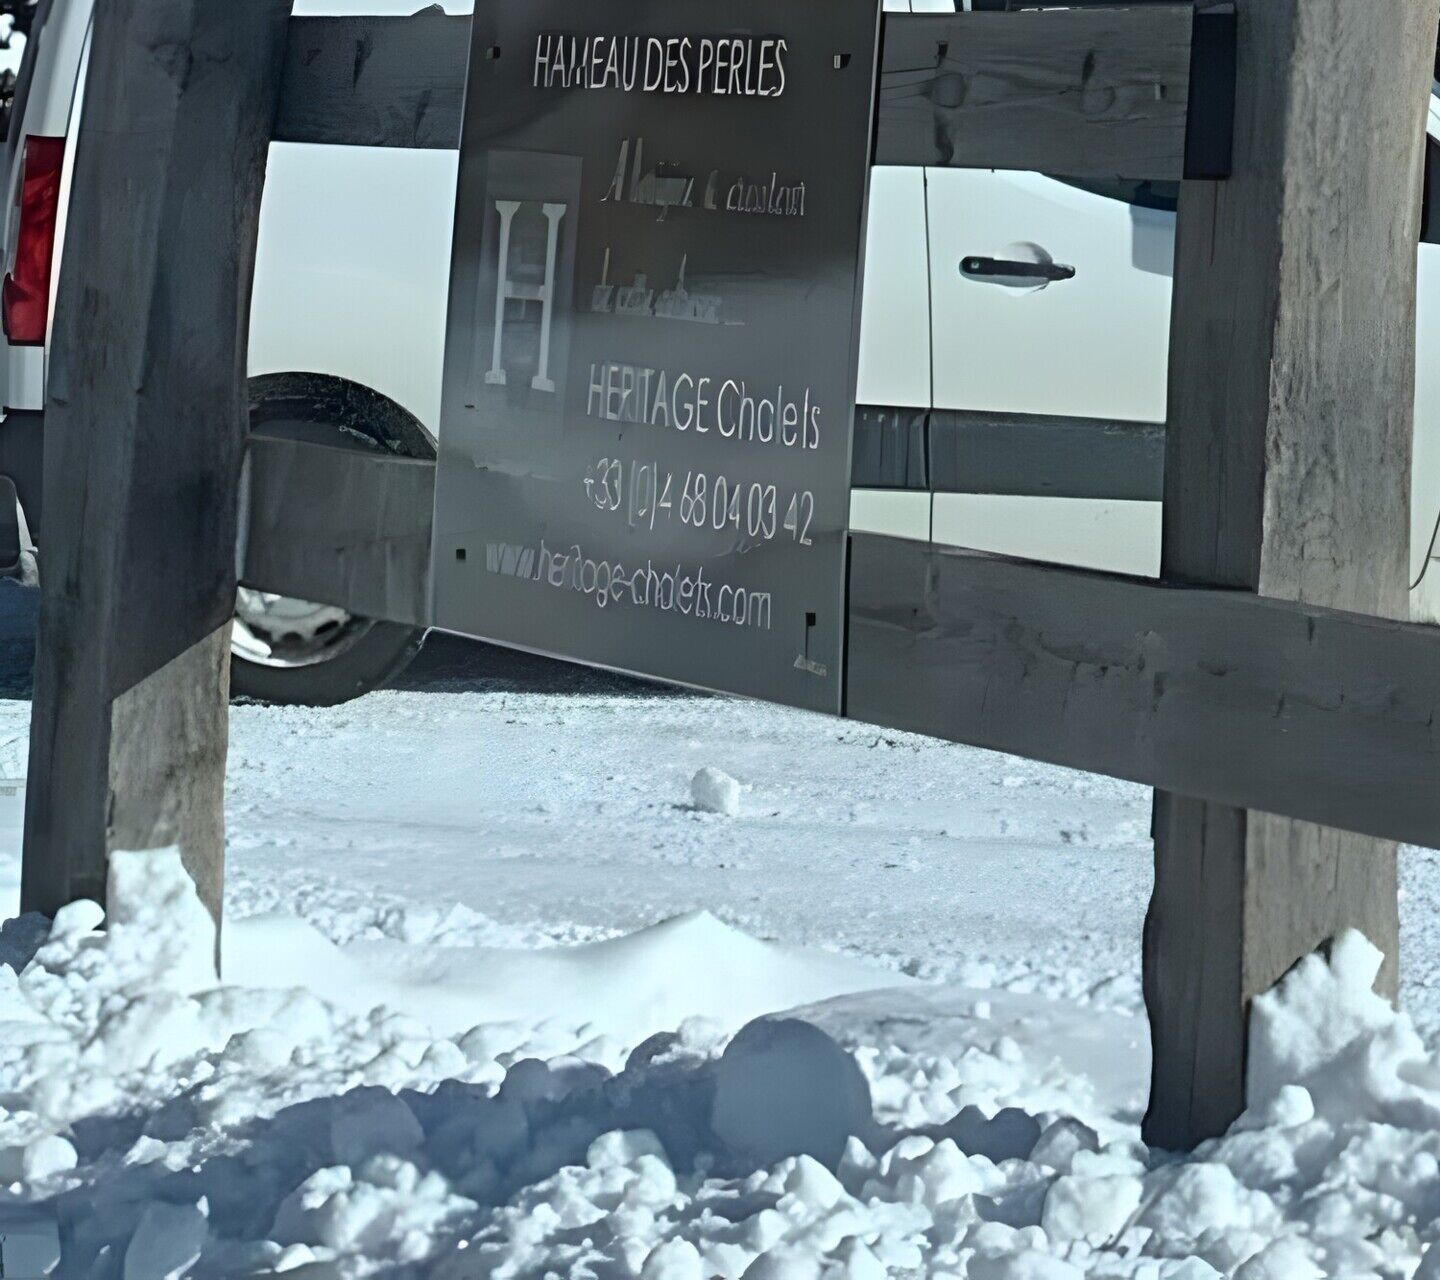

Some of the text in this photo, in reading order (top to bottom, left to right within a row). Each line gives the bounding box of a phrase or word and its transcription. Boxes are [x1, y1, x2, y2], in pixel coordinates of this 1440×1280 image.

[533, 34, 789, 97] HAMEAU DES PERLES
[484, 199, 568, 393] H
[586, 362, 711, 433] HERITAGE
[680, 470, 707, 527] 68
[713, 475, 741, 530] 04
[747, 482, 777, 539] 03
[783, 490, 814, 545] 42
